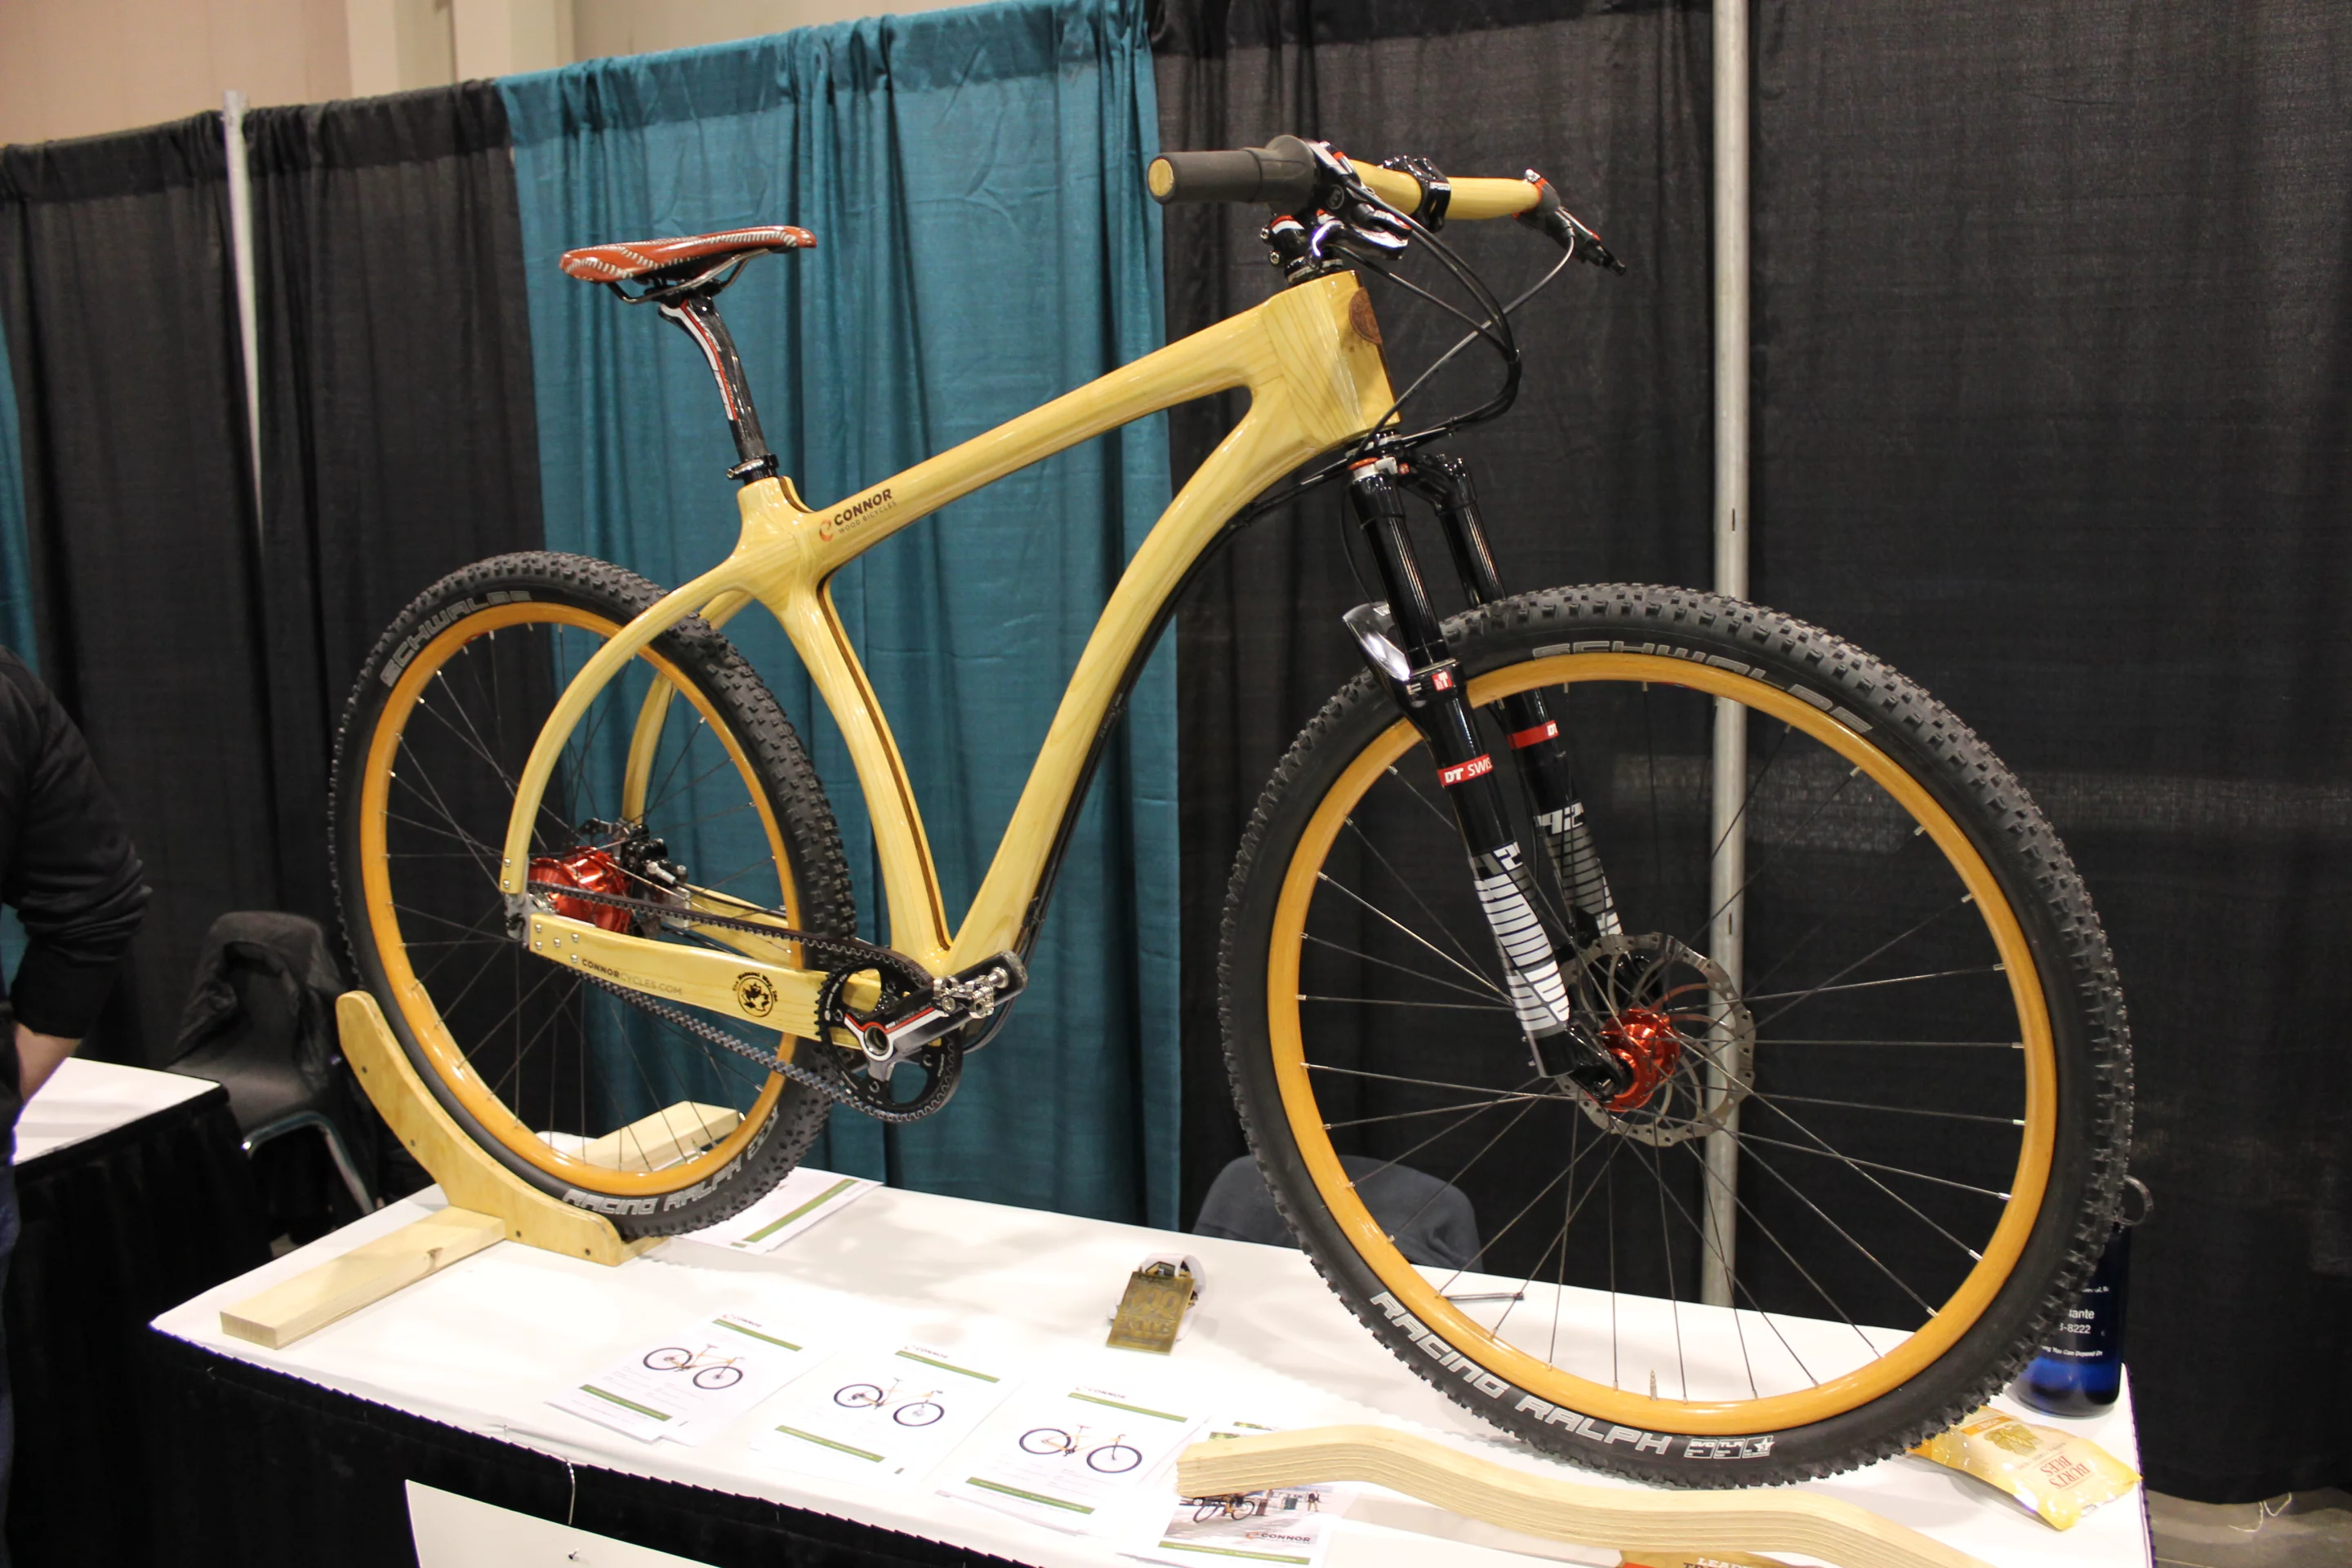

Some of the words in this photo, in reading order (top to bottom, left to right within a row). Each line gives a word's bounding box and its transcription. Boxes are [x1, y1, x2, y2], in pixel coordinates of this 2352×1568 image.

[834, 488, 893, 527] CONNOR
[838, 519, 861, 534] WOOD
[862, 500, 898, 522] BICYCLES
[380, 590, 532, 688] SCHWALBE
[1532, 640, 1873, 734] SCHWALBE
[1444, 767, 1464, 784] DT
[562, 1188, 659, 1216] RACING
[662, 1153, 742, 1212] RALPH
[1369, 1290, 1512, 1400] RACING
[1514, 1394, 1673, 1455] RALPH
[2040, 1455, 2074, 1476] BEES
[2048, 1463, 2091, 1490] BURT'S
[1261, 1532, 1312, 1544] CONNOR
